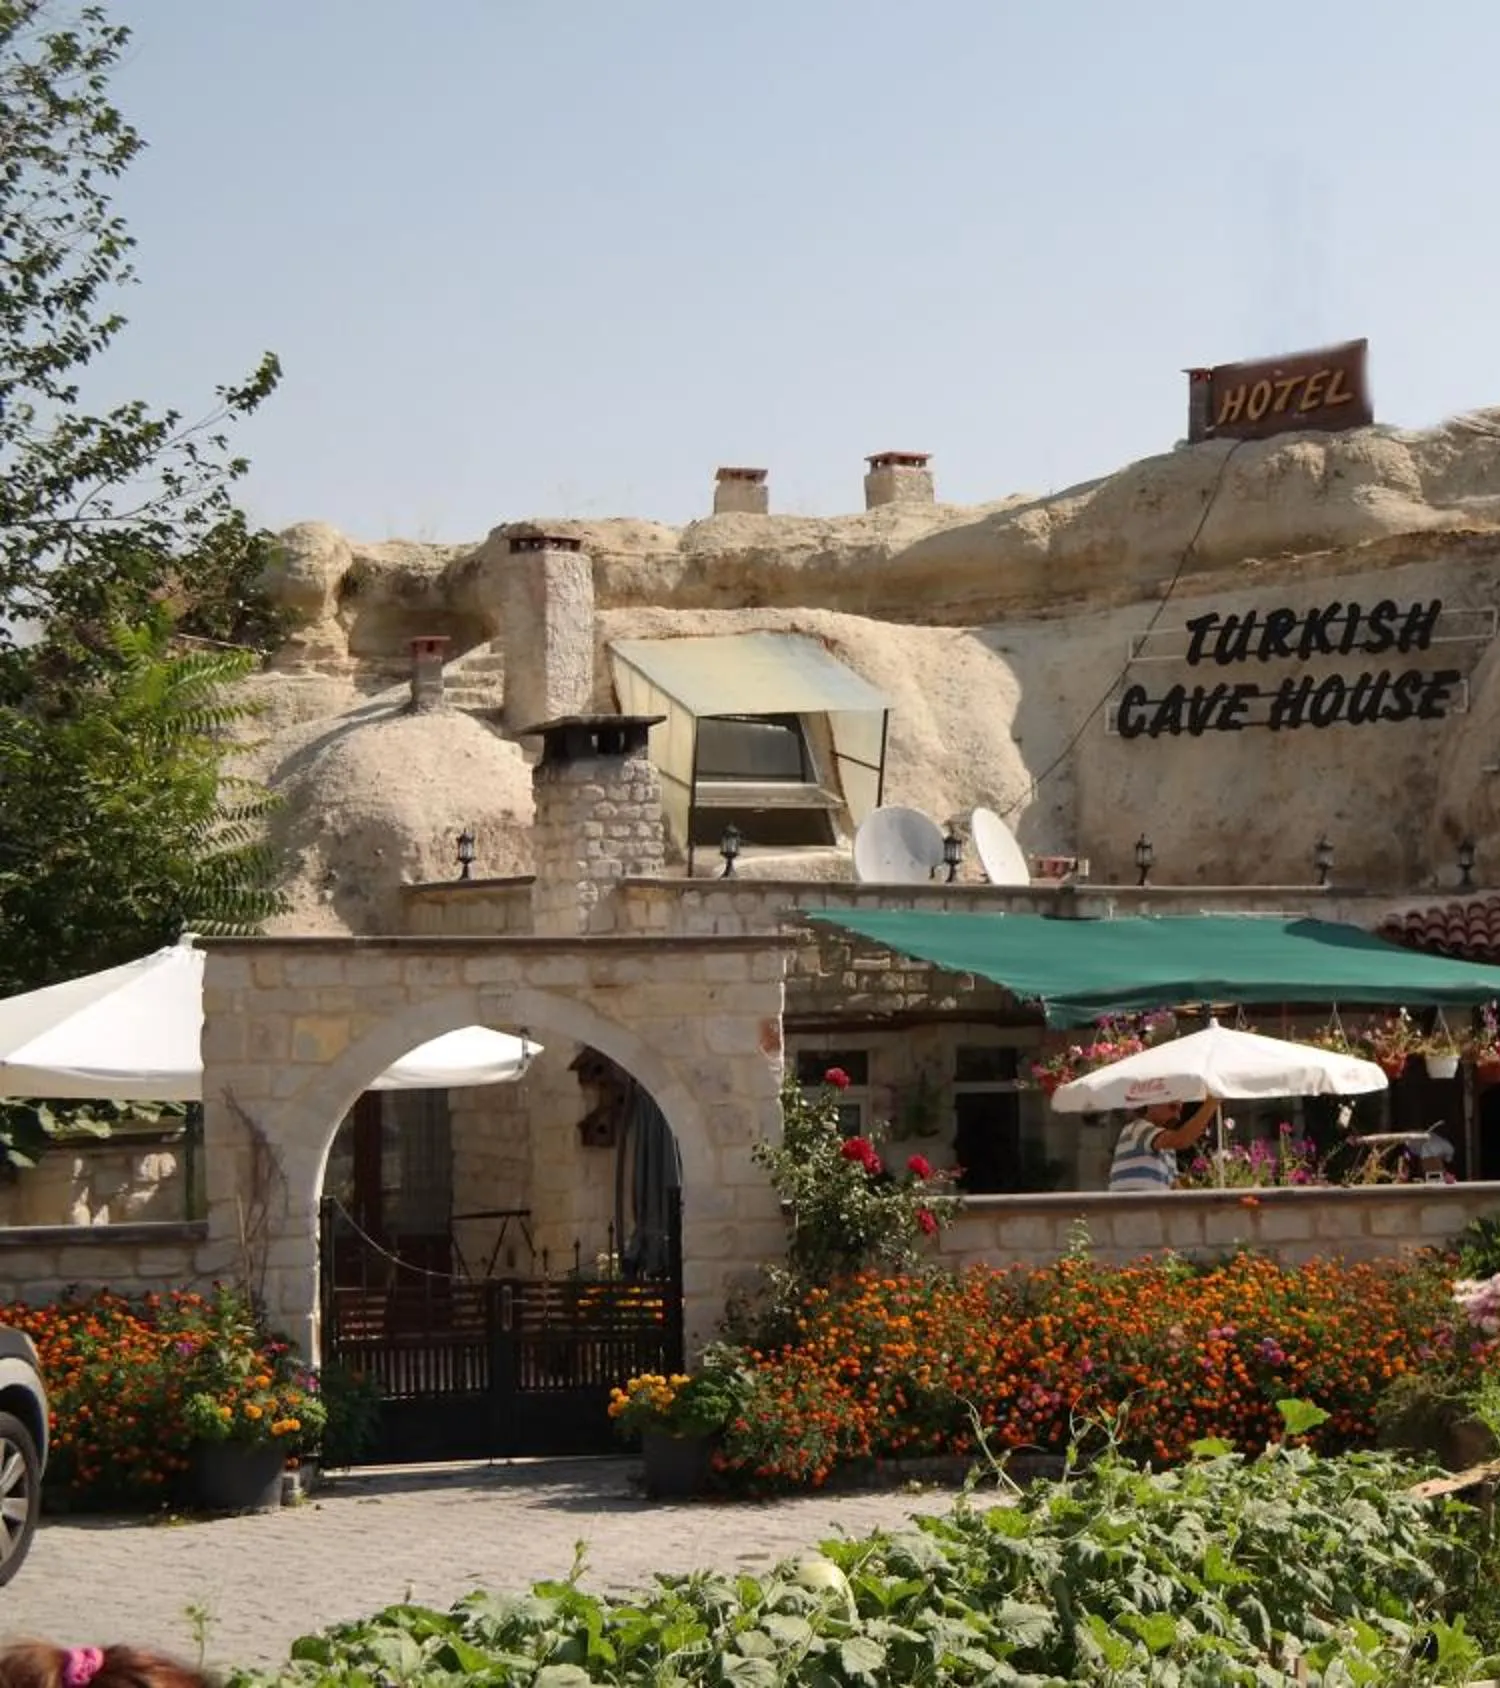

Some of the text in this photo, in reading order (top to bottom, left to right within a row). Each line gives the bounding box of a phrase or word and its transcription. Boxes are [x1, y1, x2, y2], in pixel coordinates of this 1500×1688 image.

[1217, 369, 1354, 425] HOTEL
[1185, 599, 1443, 666] TURKISH
[1117, 669, 1461, 739] CAVE HOUSE
